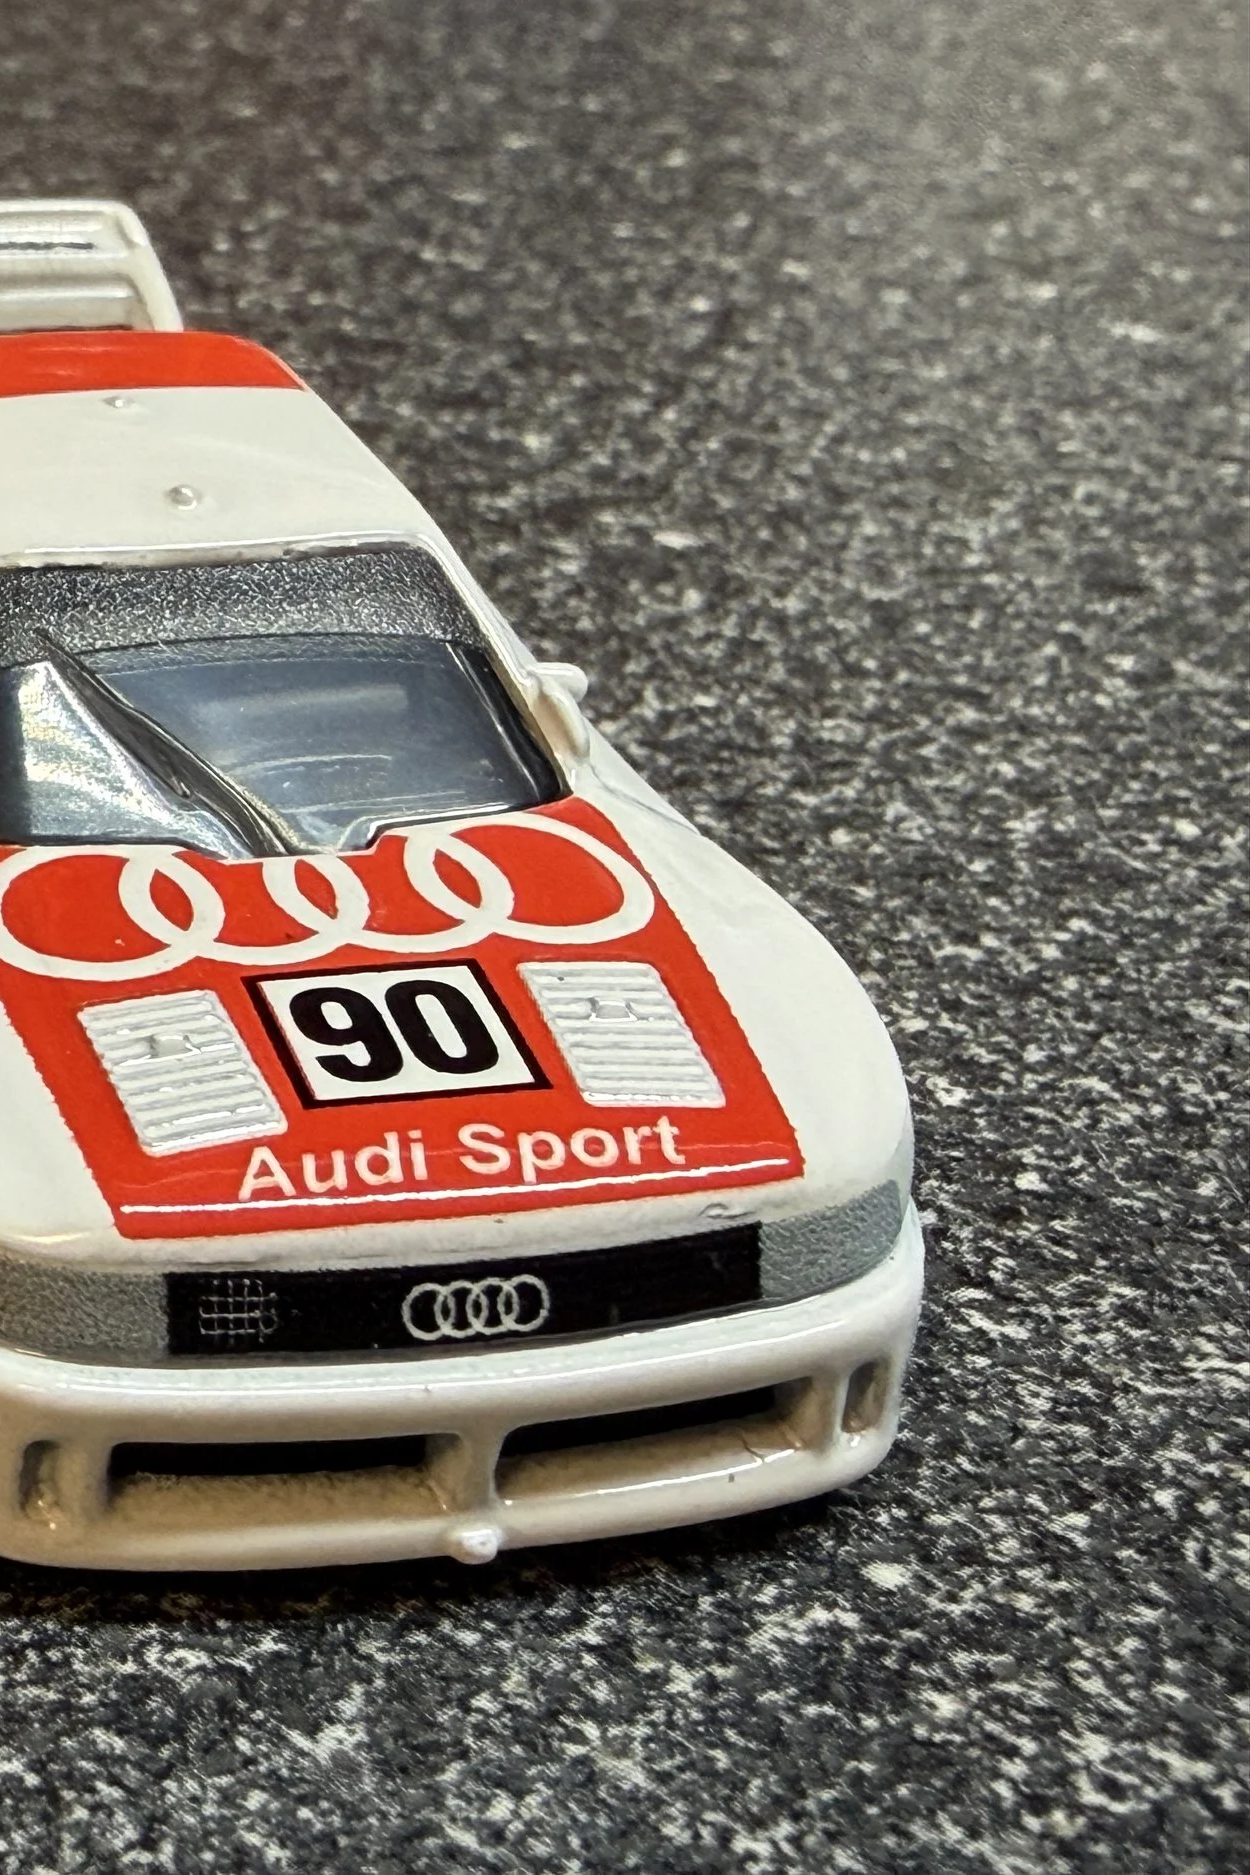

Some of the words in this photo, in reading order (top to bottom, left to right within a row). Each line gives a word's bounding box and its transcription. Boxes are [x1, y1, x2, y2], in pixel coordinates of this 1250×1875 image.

[289, 979, 500, 1083] 90
[237, 1129, 429, 1201] Audi
[458, 1115, 687, 1184] Sport
